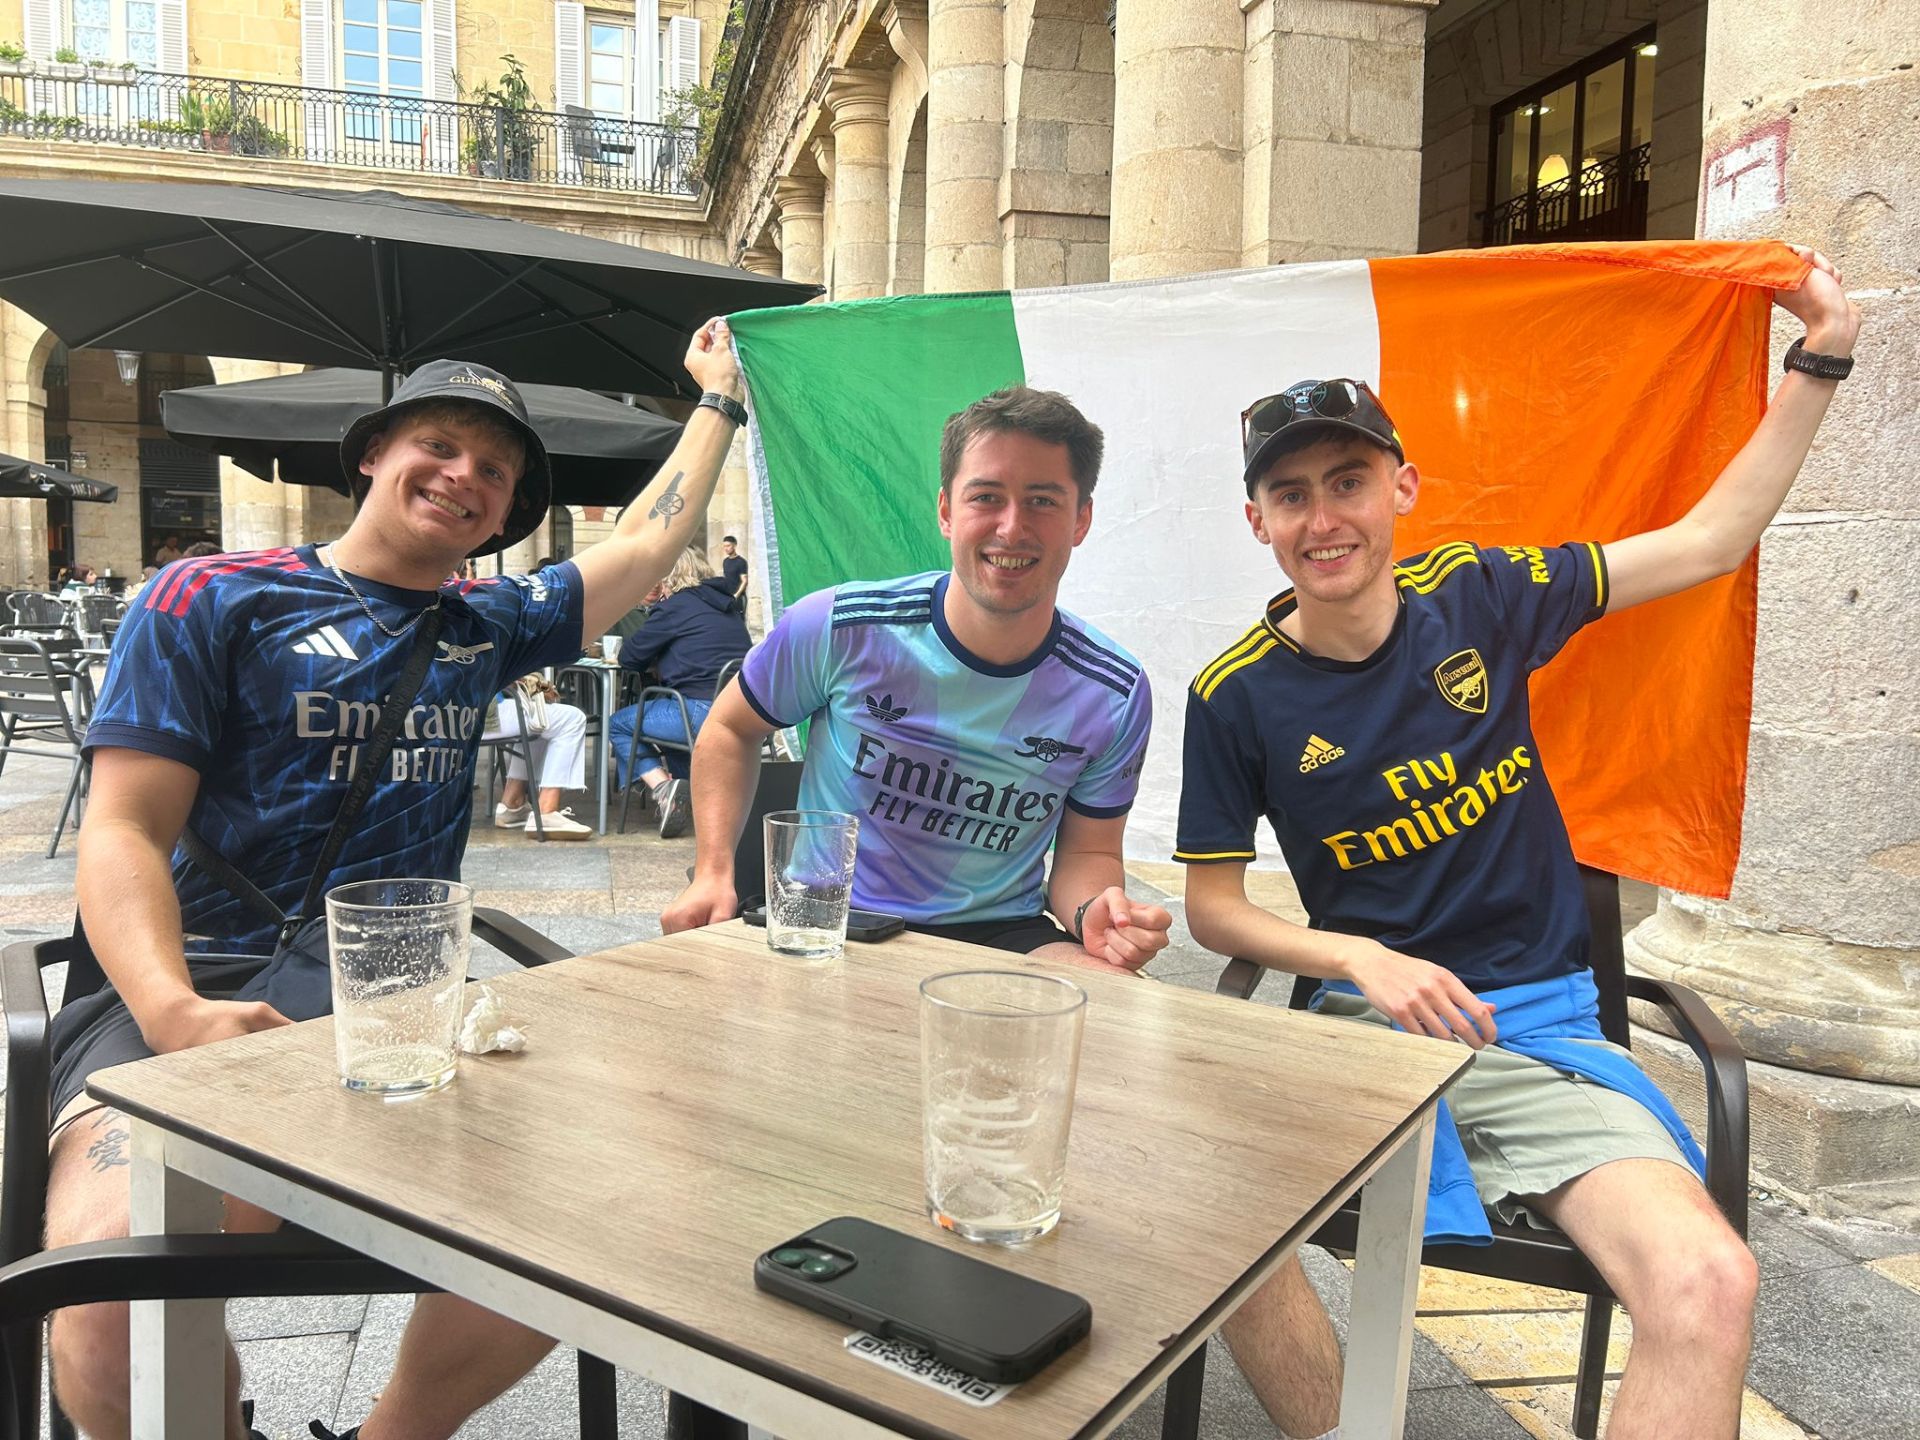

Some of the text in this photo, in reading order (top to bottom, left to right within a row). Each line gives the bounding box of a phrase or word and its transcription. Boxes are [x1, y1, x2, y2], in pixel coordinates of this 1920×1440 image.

[852, 732, 1058, 824] Emirates
[1322, 745, 1531, 871] Emirates
[1381, 751, 1457, 801] Fly
[868, 790, 1021, 852] FLY BETTER
